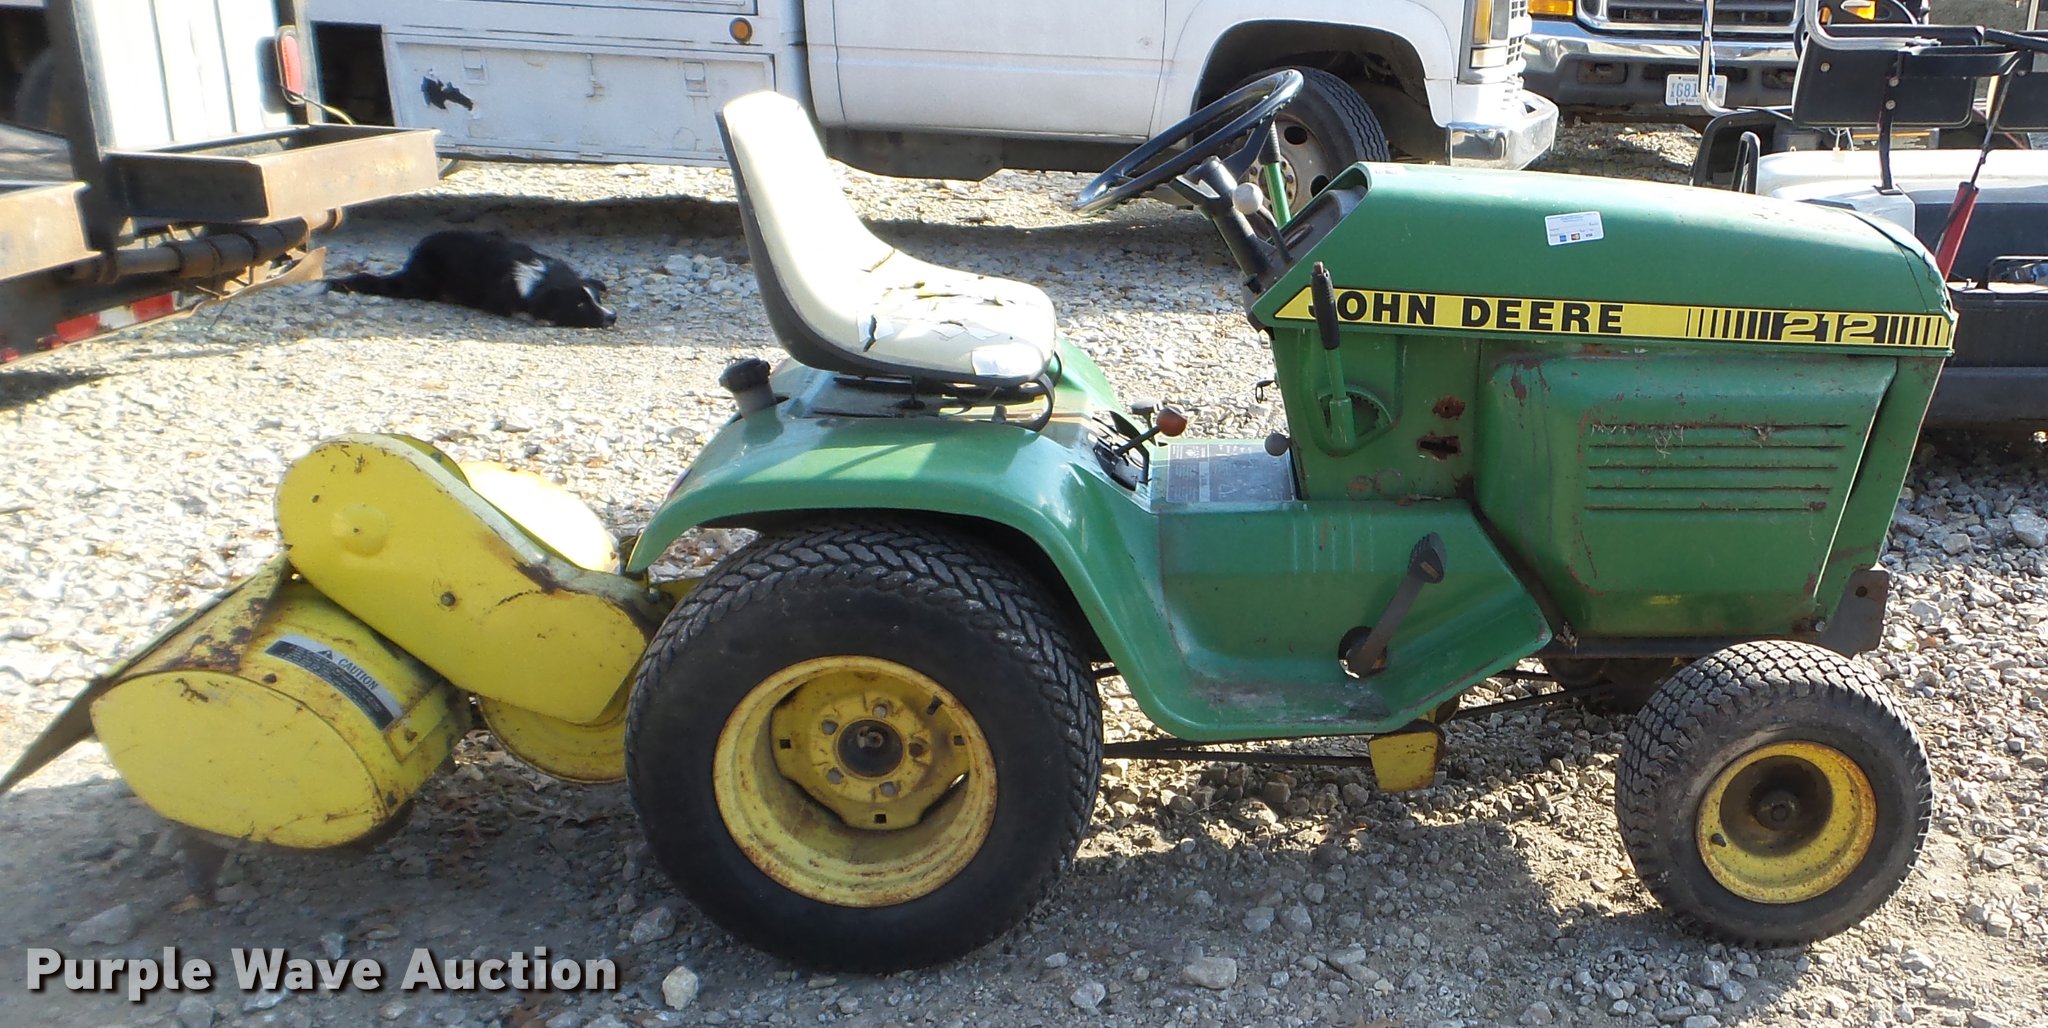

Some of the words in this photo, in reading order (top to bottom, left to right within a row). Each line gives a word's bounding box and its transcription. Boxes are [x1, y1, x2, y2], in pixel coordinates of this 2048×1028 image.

[1676, 82, 1711, 98] G81
[1461, 297, 1624, 334] DEERE
[1781, 311, 1878, 344] 212
[338, 658, 379, 690] CAUTION
